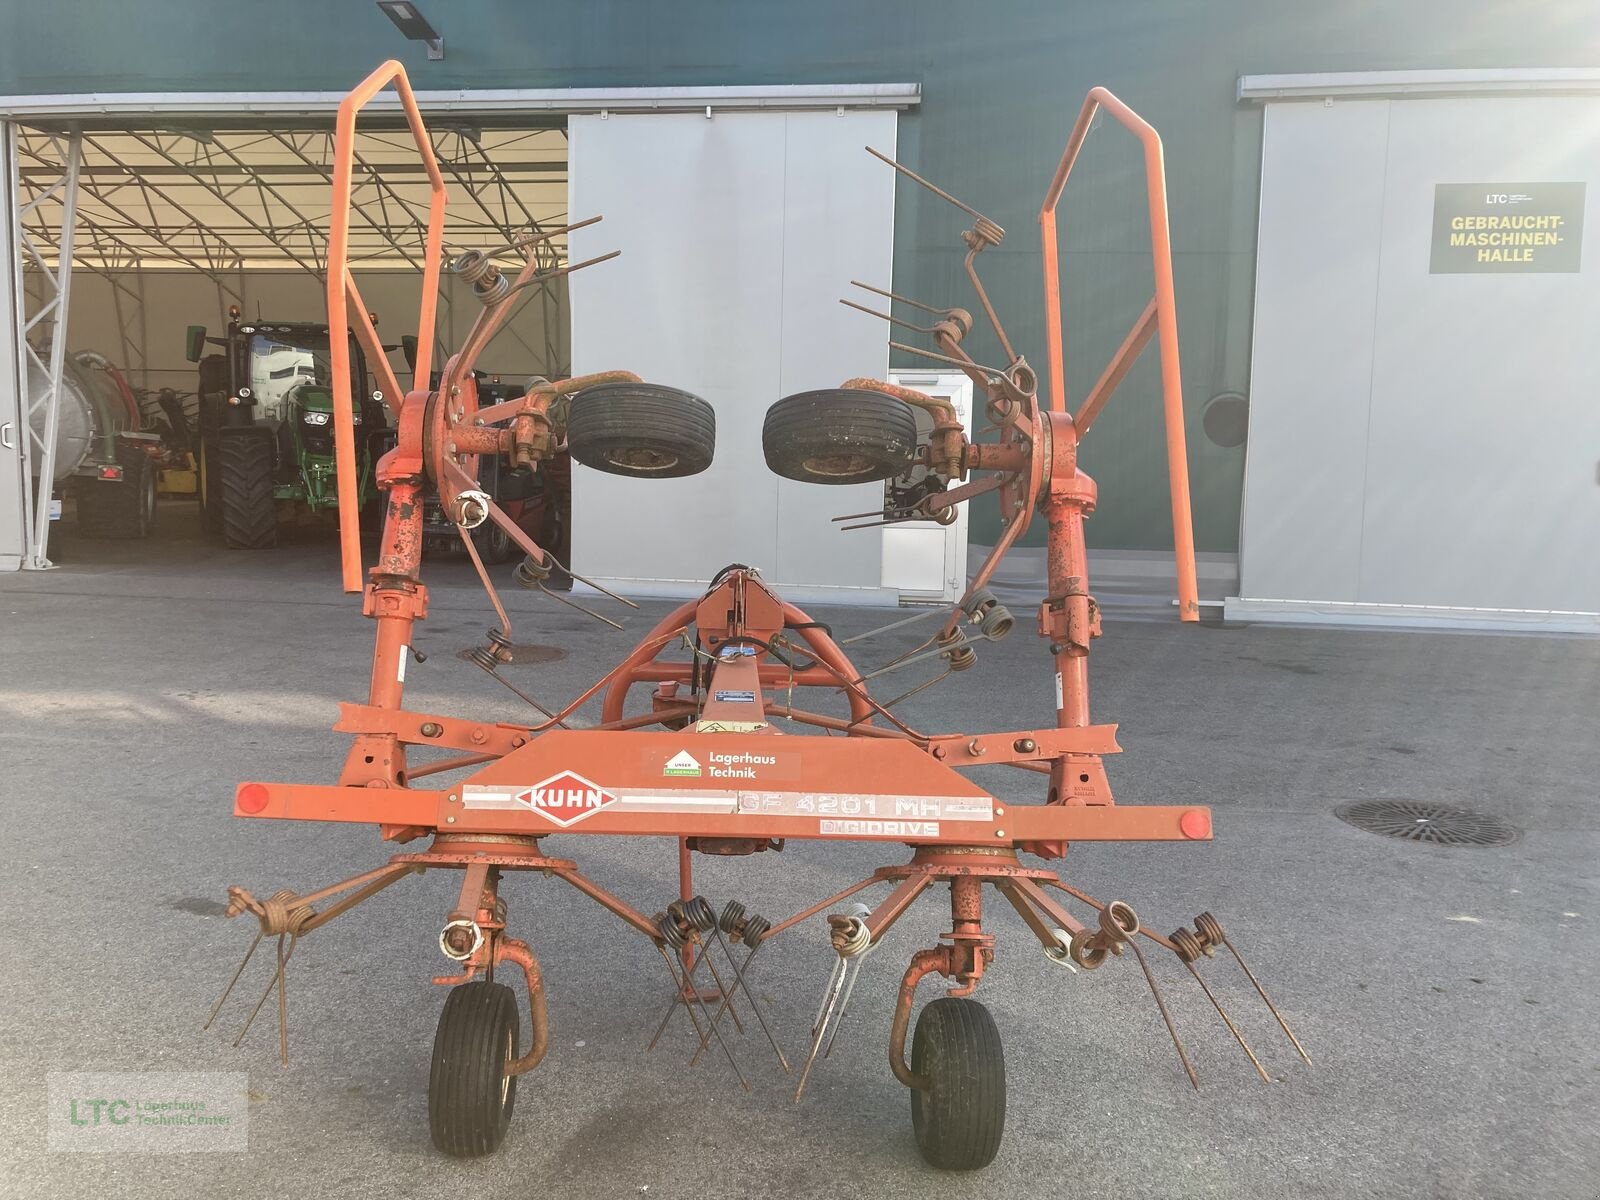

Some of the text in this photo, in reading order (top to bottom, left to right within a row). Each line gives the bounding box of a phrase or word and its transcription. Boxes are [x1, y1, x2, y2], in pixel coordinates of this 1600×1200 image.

[1486, 194, 1508, 204] LTC
[1451, 215, 1565, 230] GEBRAUCHT-
[1450, 232, 1564, 246] MASCHINEN-
[1477, 249, 1534, 262] HALLE
[709, 751, 776, 765] Lagerhaus
[708, 766, 756, 779] Technik
[530, 789, 602, 808] KUHN
[796, 795, 875, 815] 4201
[895, 798, 941, 817] MH
